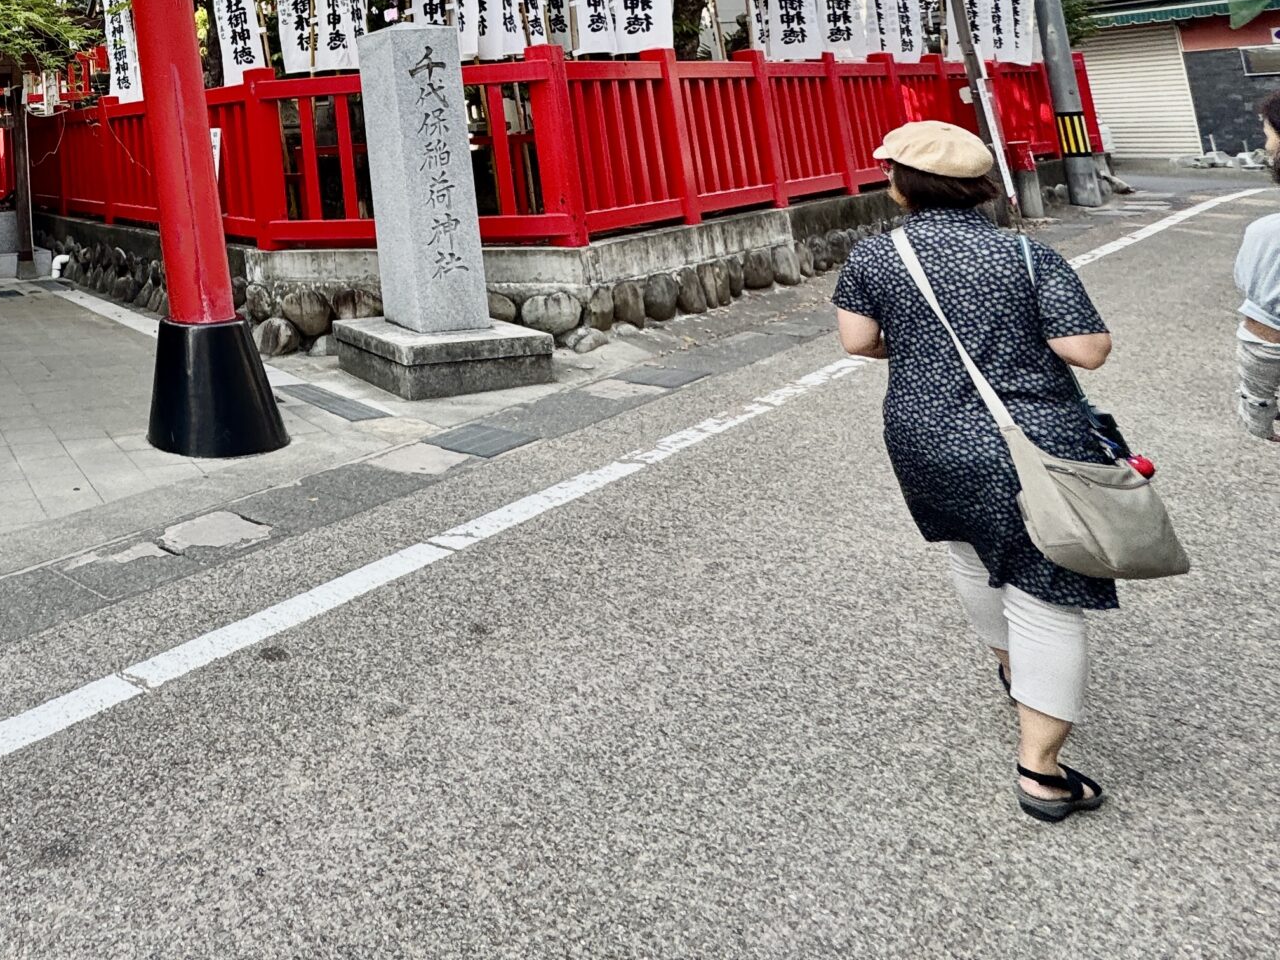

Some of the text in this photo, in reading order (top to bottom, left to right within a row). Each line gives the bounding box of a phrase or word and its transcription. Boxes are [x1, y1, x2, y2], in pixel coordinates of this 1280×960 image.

[408, 45, 469, 280] 千代保稲荷神社
